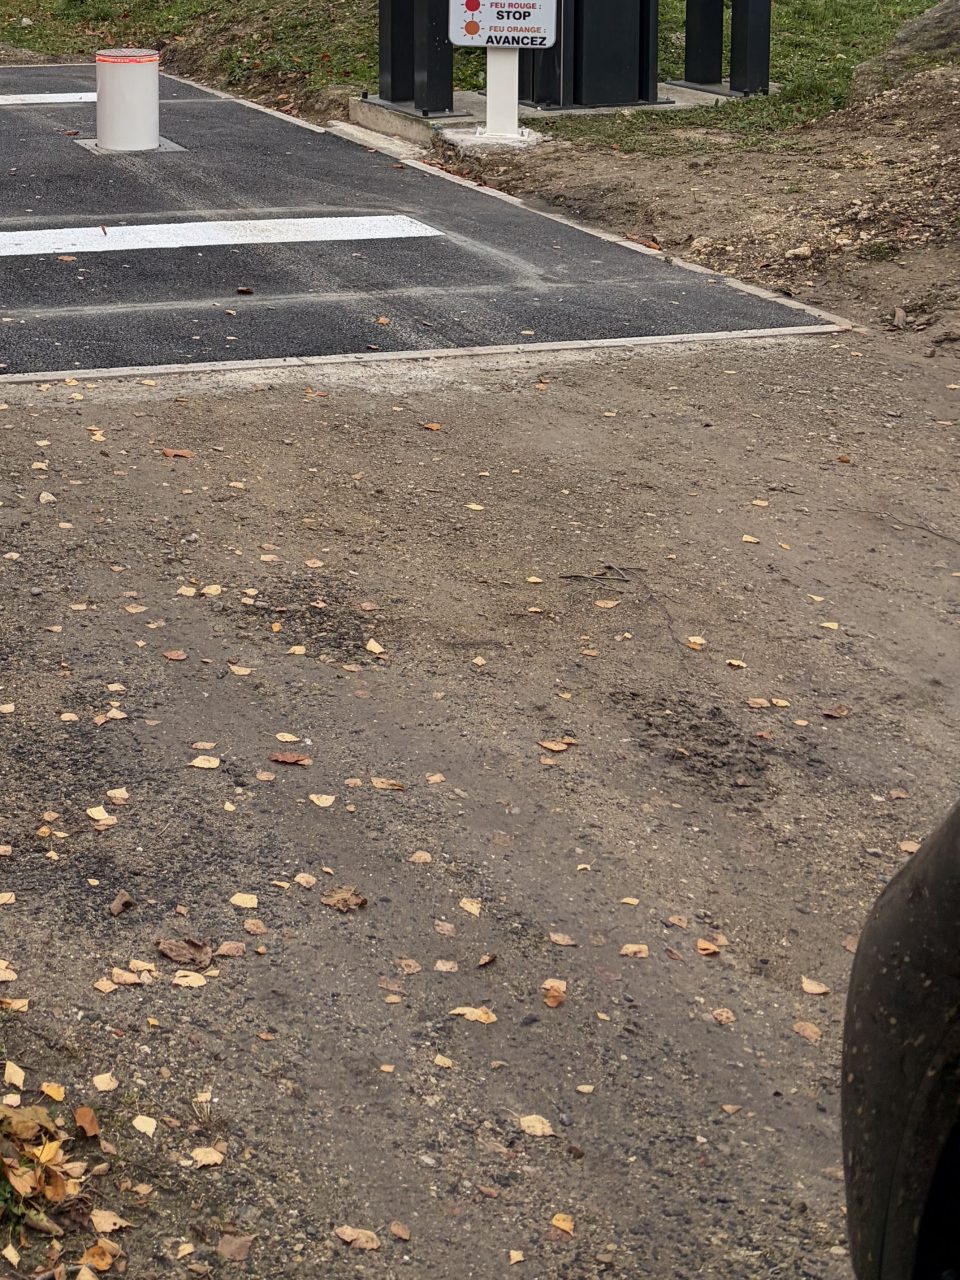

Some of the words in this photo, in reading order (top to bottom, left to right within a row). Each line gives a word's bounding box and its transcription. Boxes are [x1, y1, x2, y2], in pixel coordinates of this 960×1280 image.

[508, 2, 537, 10] ROUGE
[496, 10, 531, 20] STOP
[485, 35, 547, 46] AVANCEZ
